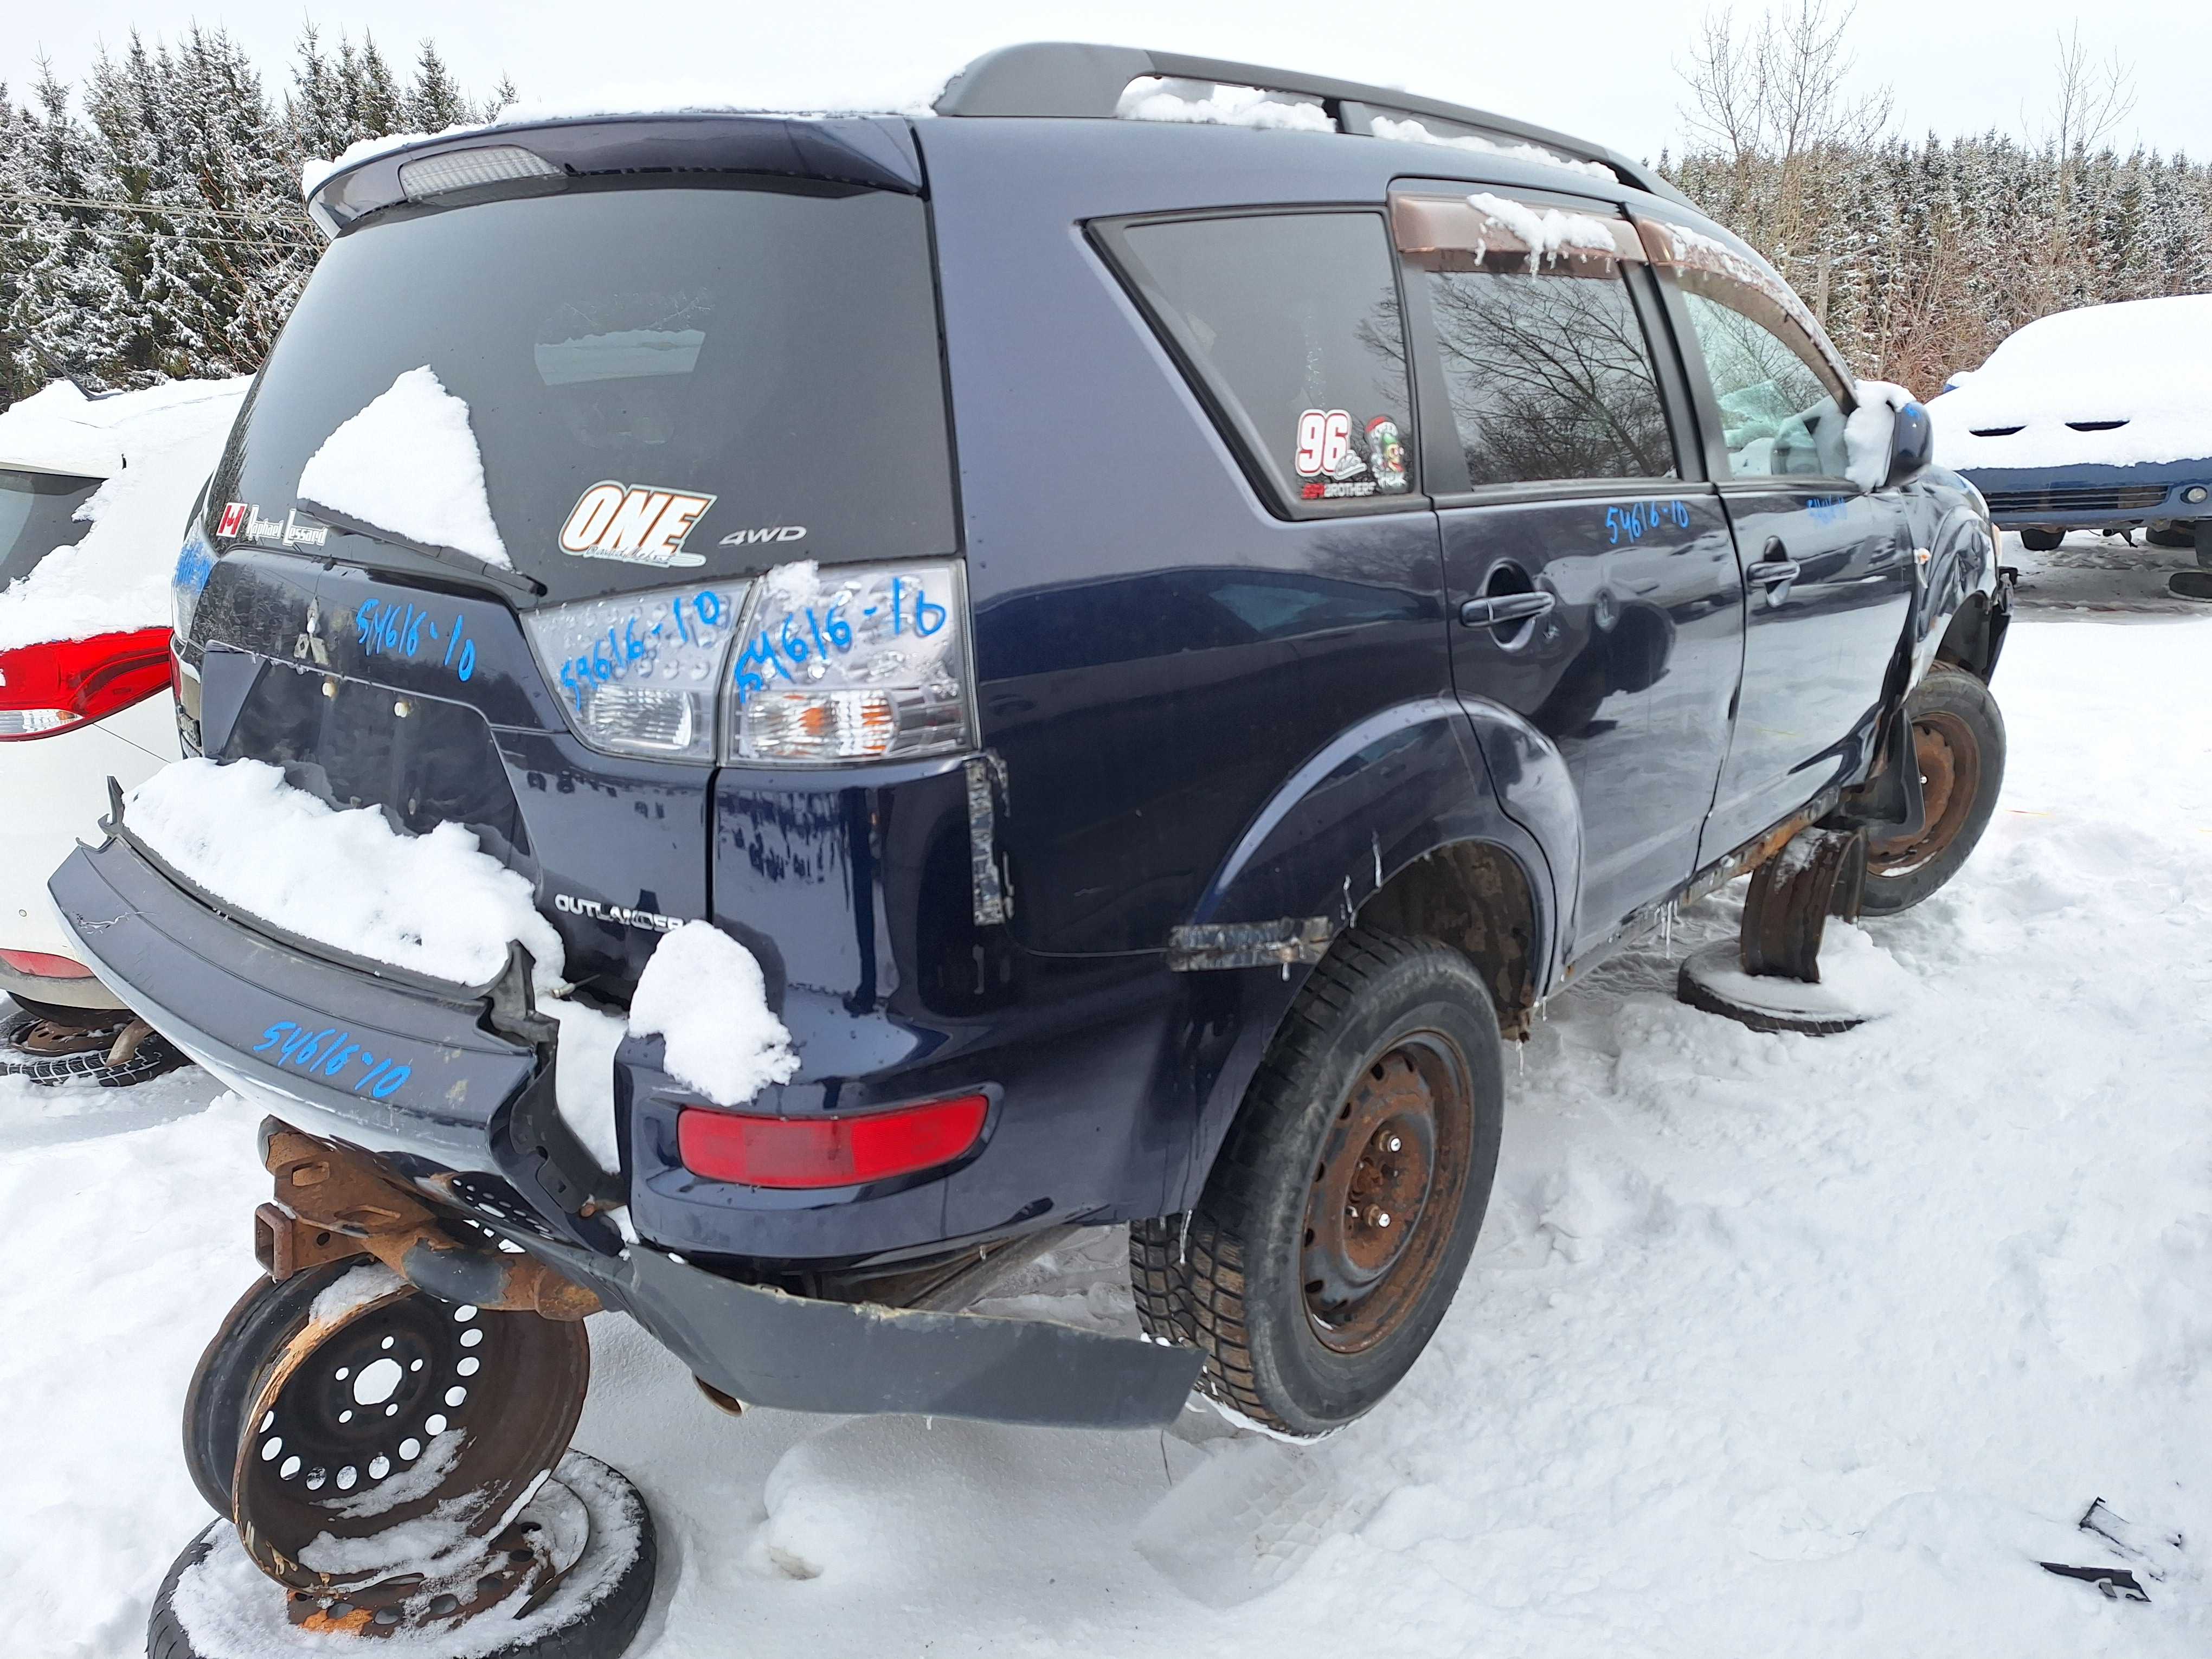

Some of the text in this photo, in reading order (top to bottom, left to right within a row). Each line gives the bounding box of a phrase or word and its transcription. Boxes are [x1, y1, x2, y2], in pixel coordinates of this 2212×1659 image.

[1298, 411, 1351, 474] 96
[246, 505, 329, 546] Raphael Lessard
[561, 484, 711, 555] ONE
[718, 526, 807, 546] 4WD
[1605, 500, 1689, 544] 54616-10
[356, 599, 476, 681] 54616-10
[555, 893, 684, 934] OUTLANDER
[253, 1021, 412, 1098] 54616-10
